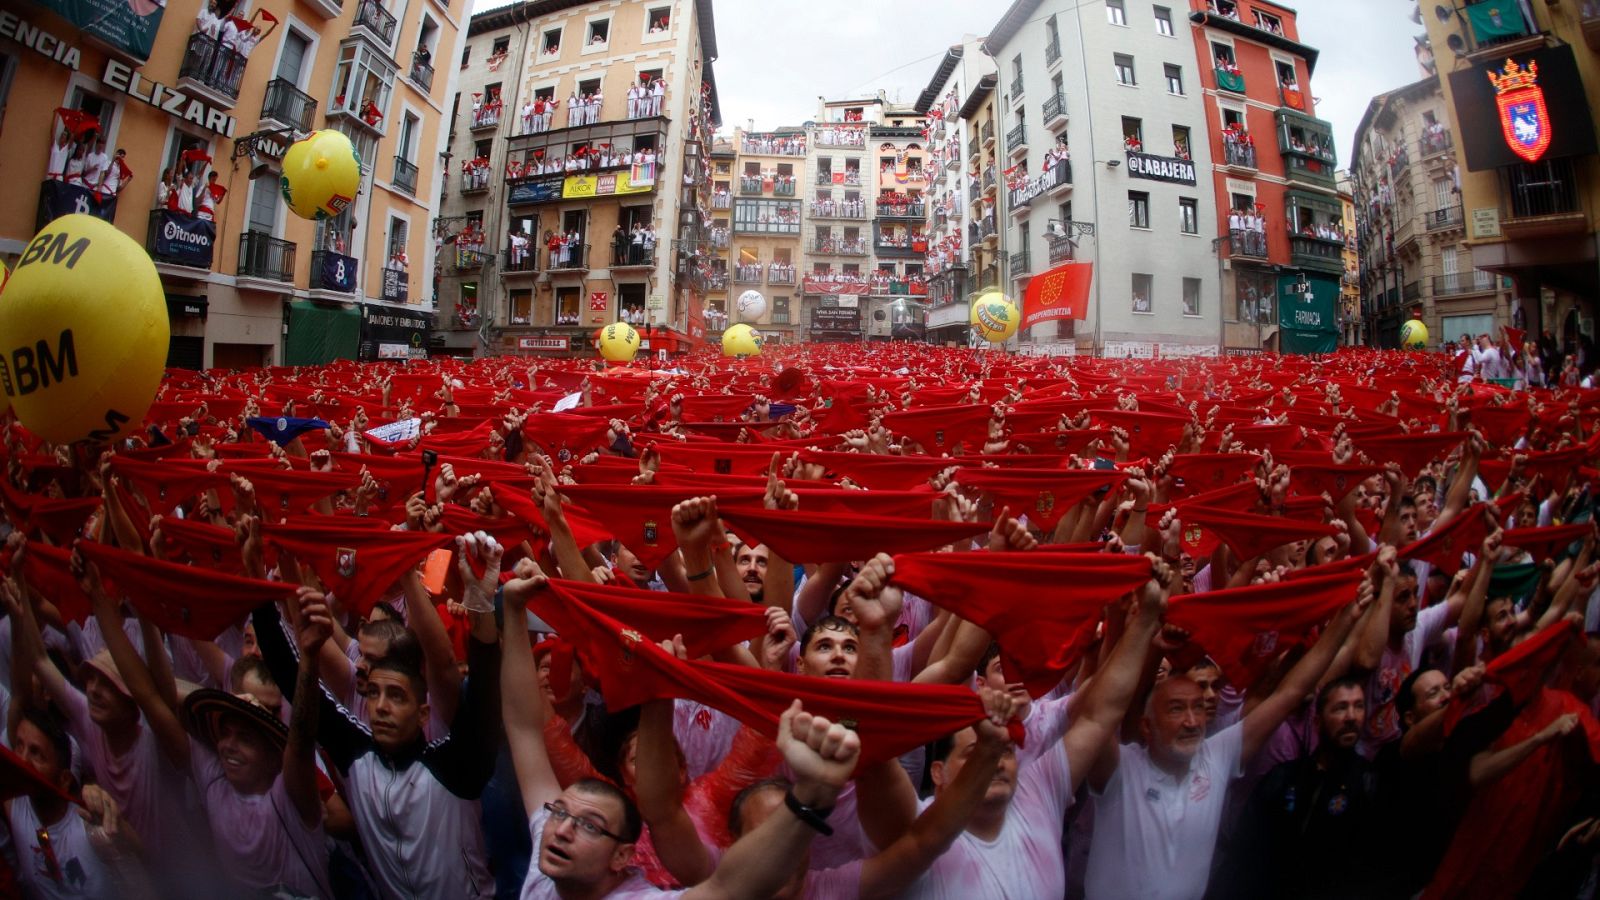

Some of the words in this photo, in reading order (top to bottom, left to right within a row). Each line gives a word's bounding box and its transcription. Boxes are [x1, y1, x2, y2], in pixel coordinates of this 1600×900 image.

[103, 58, 237, 138] ELIZARI
[1128, 157, 1195, 181] @LABAJERA
[18, 233, 91, 270] BM
[1295, 310, 1320, 325] FARMACIA
[608, 326, 616, 340] BM
[12, 328, 79, 396] BM
